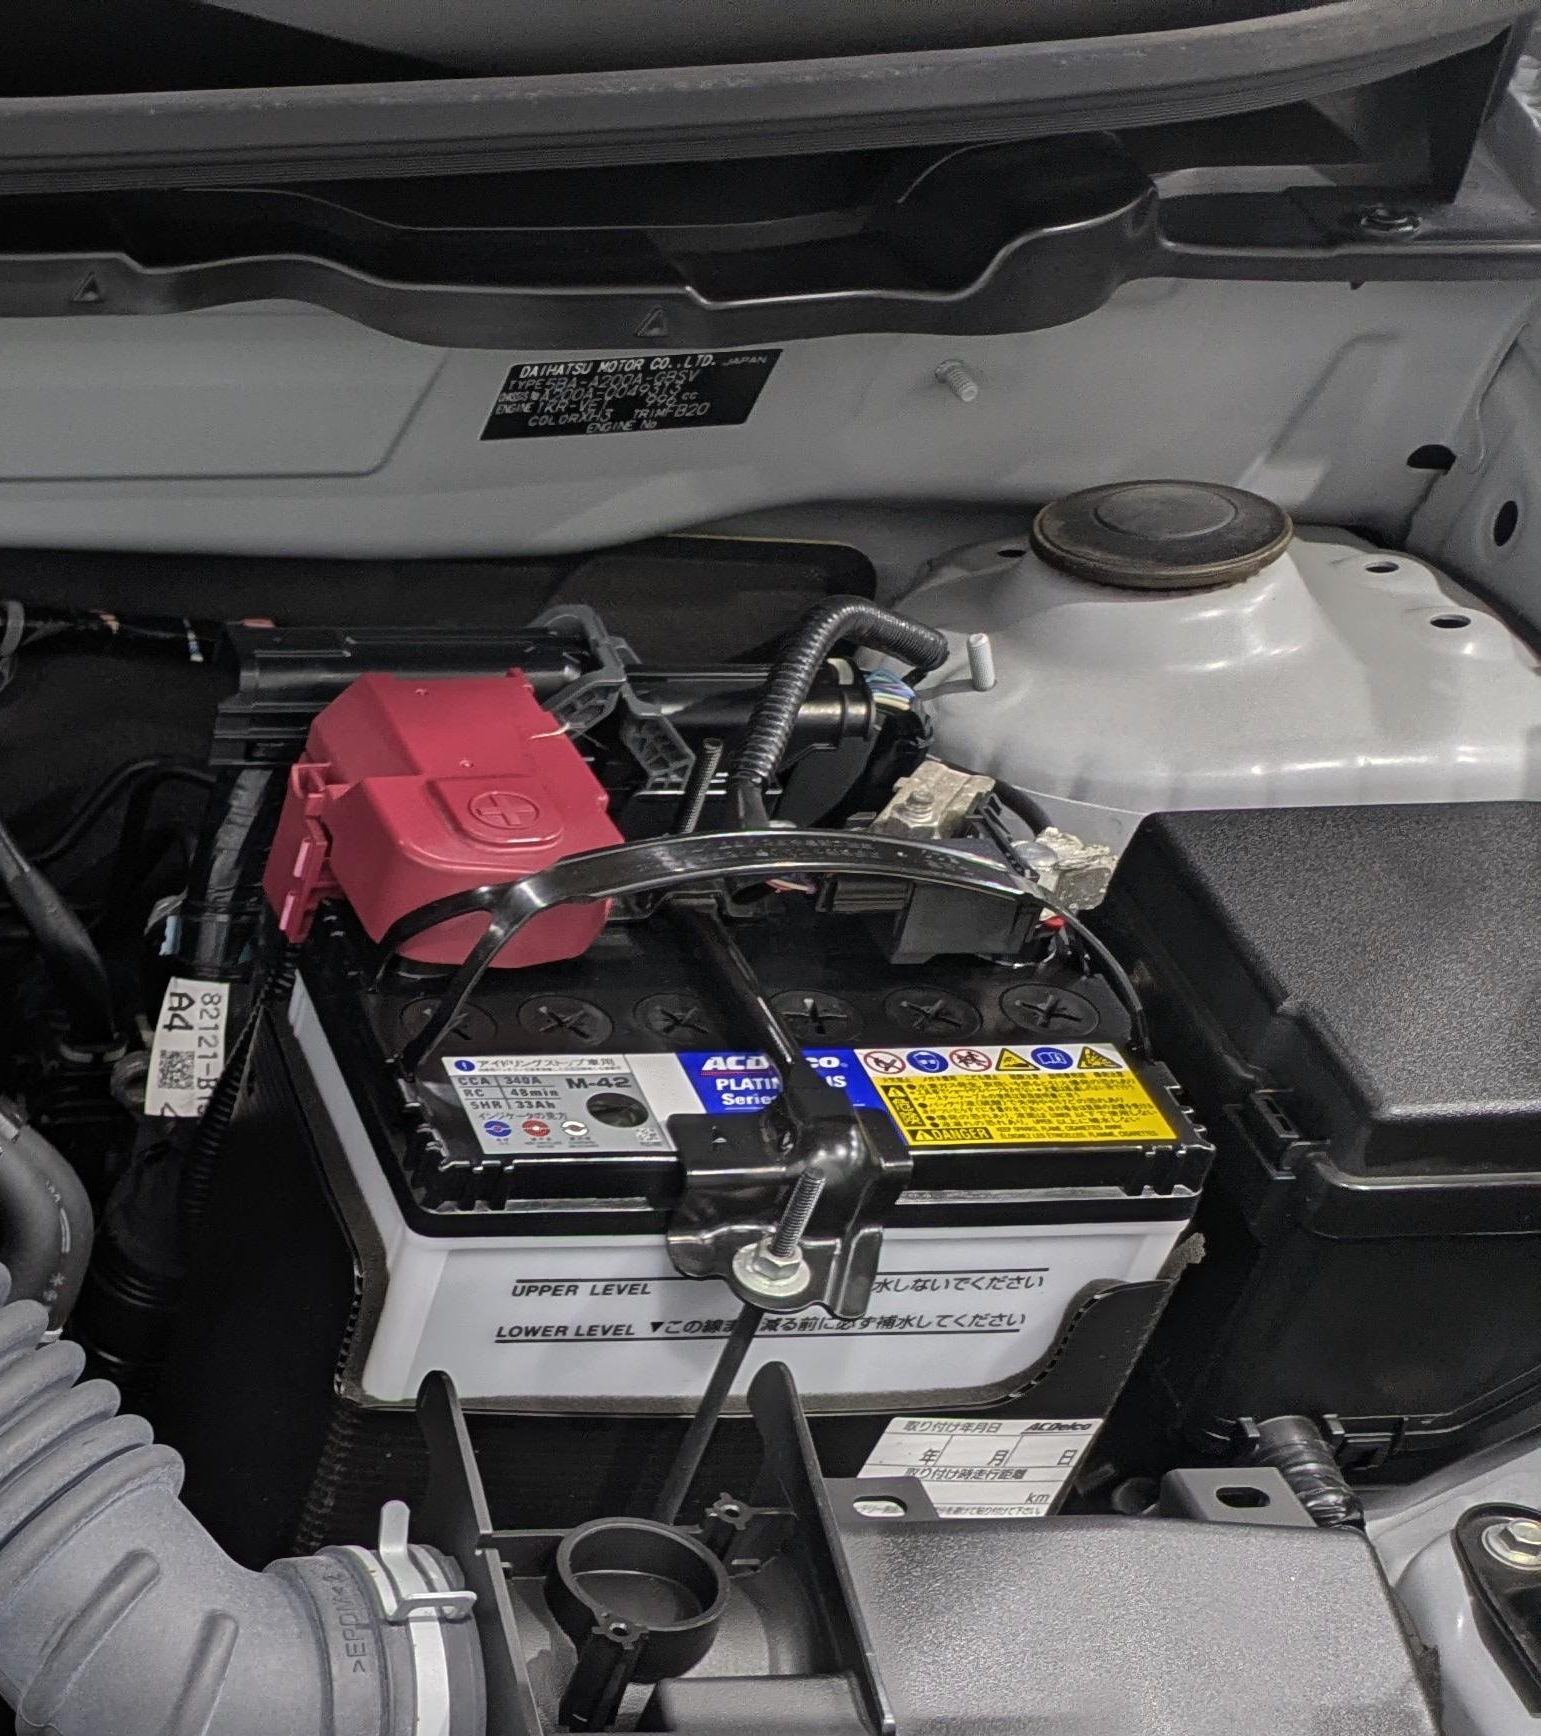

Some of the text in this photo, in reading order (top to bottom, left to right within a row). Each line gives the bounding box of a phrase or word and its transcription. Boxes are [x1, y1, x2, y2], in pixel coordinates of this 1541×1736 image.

[519, 361, 592, 379] DAIHATSU
[597, 357, 645, 374] MOTOR
[162, 991, 196, 1033] A4
[458, 1076, 491, 1086] CCA
[565, 1076, 633, 1090] M-42
[720, 1092, 778, 1107] Serie
[931, 1128, 989, 1141] DANGER
[511, 1282, 652, 1298] UPPER LEVEL
[495, 1323, 636, 1339] LOWER LEVEL
[903, 1420, 1004, 1434] 取り付け年月日
[1025, 1421, 1094, 1432] ACDelco
[918, 1447, 1078, 1466] 年 月 日
[1024, 1491, 1051, 1505] km
